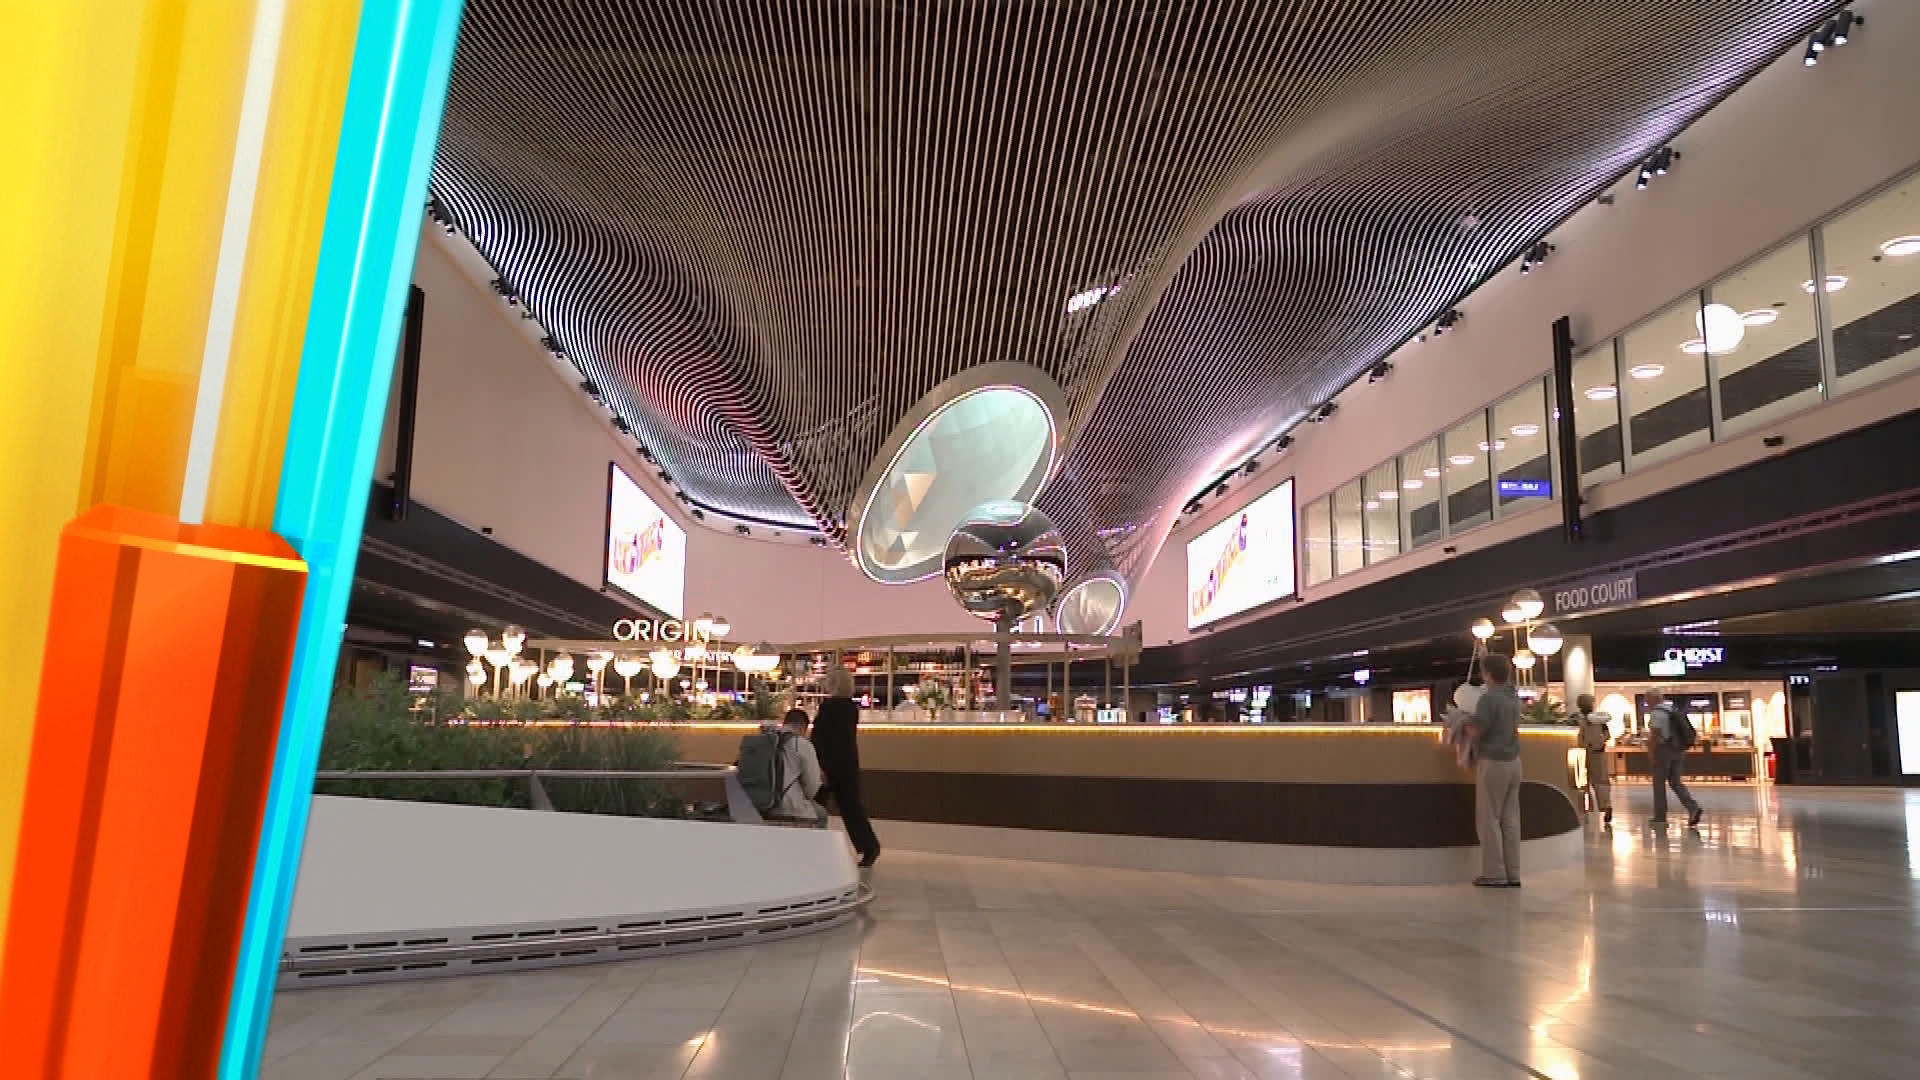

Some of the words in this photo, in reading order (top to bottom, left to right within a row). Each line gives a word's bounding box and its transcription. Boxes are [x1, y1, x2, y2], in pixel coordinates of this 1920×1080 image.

[1555, 588, 1588, 612] FOOD
[1591, 578, 1633, 605] COURT
[1664, 648, 1724, 662] CHRIST
